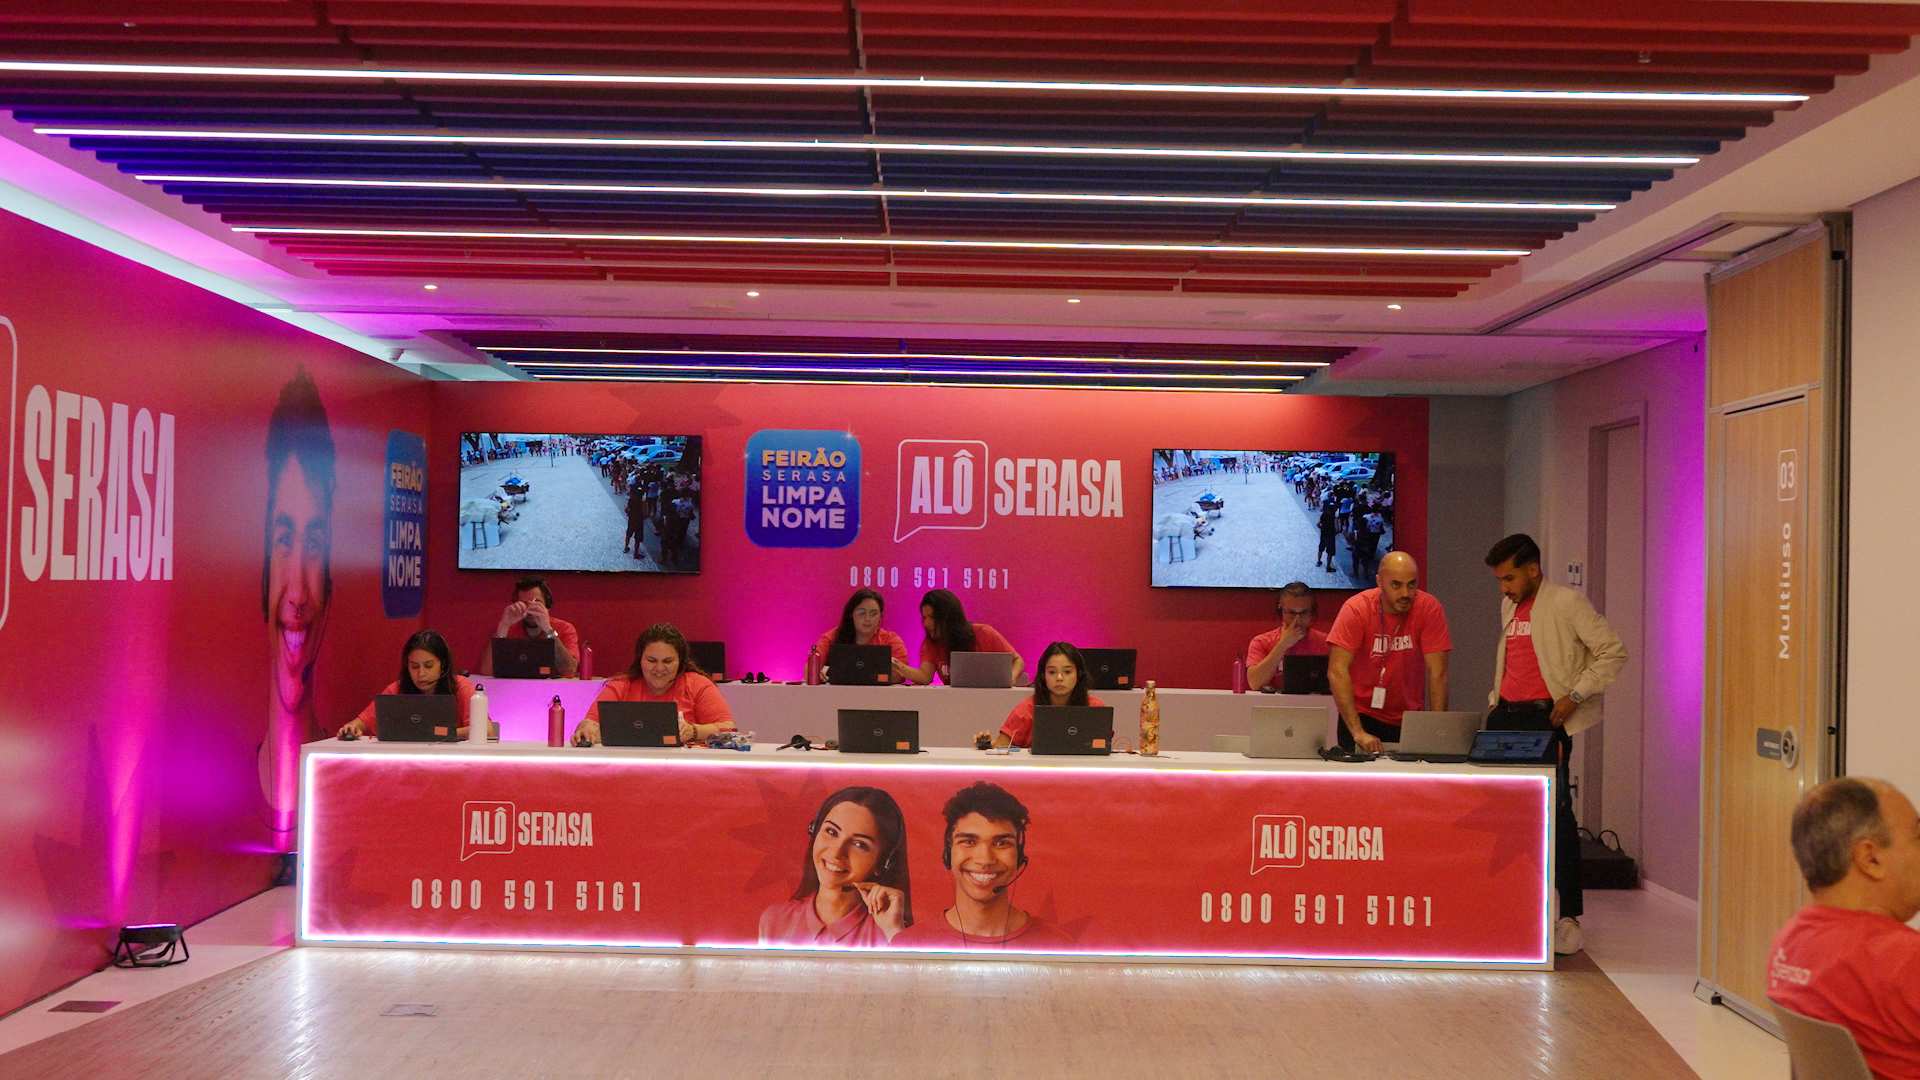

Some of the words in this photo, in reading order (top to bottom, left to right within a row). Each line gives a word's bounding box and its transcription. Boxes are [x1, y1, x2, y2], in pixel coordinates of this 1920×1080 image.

[762, 447, 846, 468] FEIRÃO
[20, 384, 175, 582] SERASA
[390, 461, 424, 492] FEIRÃO
[762, 470, 846, 482] SERASA
[910, 448, 975, 515] ALÔ
[994, 457, 1124, 518] SERASA
[1779, 460, 1796, 490] 03
[390, 494, 422, 514] SERASA
[762, 485, 845, 505] LIMPA
[761, 507, 845, 529] NOME
[389, 520, 422, 550] LIMPA
[388, 554, 421, 587] NOME
[850, 566, 899, 588] 0800
[914, 566, 949, 589] 591
[963, 567, 1009, 590] 5161
[1778, 522, 1792, 660] Multiuso
[470, 806, 507, 846] ALÔ
[518, 811, 594, 847] SERASA
[1260, 820, 1297, 860] ALÔ
[1308, 825, 1384, 861] SERASA
[411, 878, 482, 910] 0800
[504, 879, 554, 911] 591
[576, 880, 641, 912] 5161
[1201, 891, 1272, 925] 0800
[1294, 893, 1344, 926] 591
[1366, 895, 1432, 927] 5161
